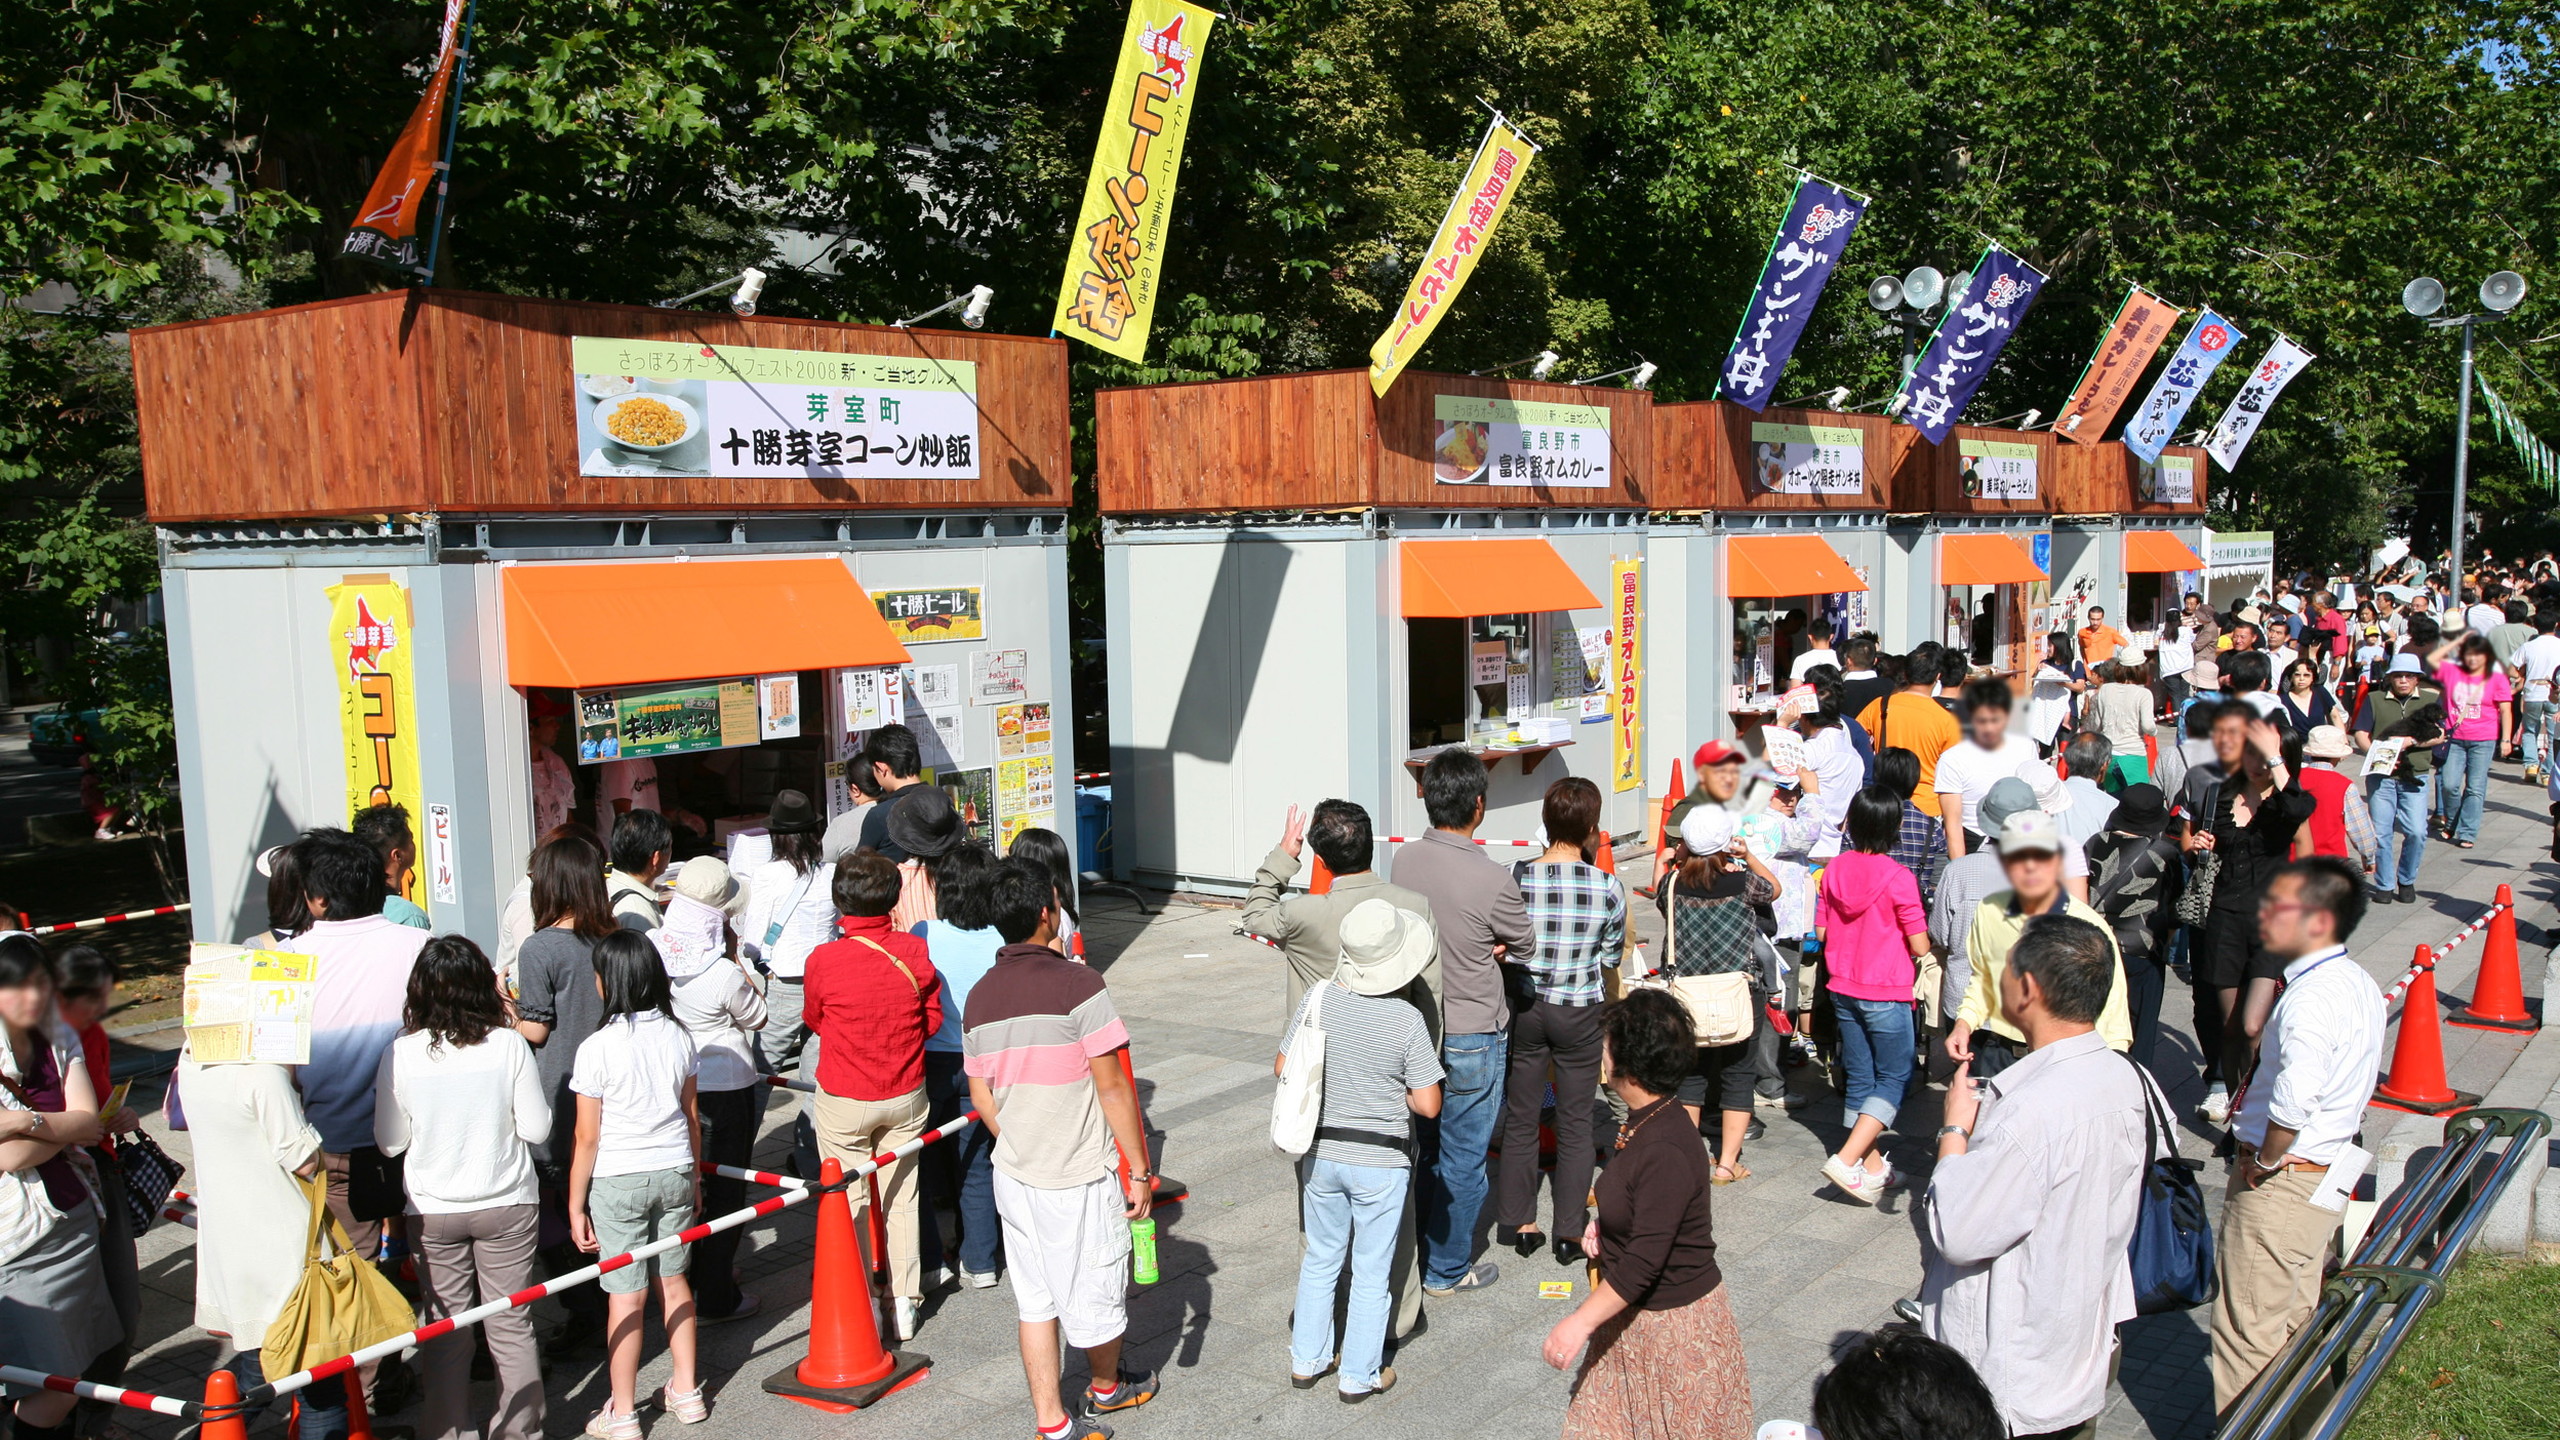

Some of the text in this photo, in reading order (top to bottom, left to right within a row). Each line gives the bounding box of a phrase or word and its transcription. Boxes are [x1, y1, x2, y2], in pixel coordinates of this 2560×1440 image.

[1726, 241, 1829, 396] ザンギ丼
[1907, 302, 2010, 429] ザンギ丼
[806, 393, 901, 426] 芽室町
[2139, 356, 2203, 445] 塩やきそば
[2222, 384, 2271, 455] 塩やきば
[720, 428, 972, 469] 十勝芽室コーン炒飯
[1521, 430, 1580, 451] 富良野市
[1498, 454, 1605, 480] 富良野オムカレー
[890, 592, 967, 617] 十勝ビール
[345, 624, 396, 648] 十勝芽室
[1621, 572, 1637, 750] 富良野オムカレー
[884, 676, 900, 725] ビー
[435, 817, 451, 886] ビール
